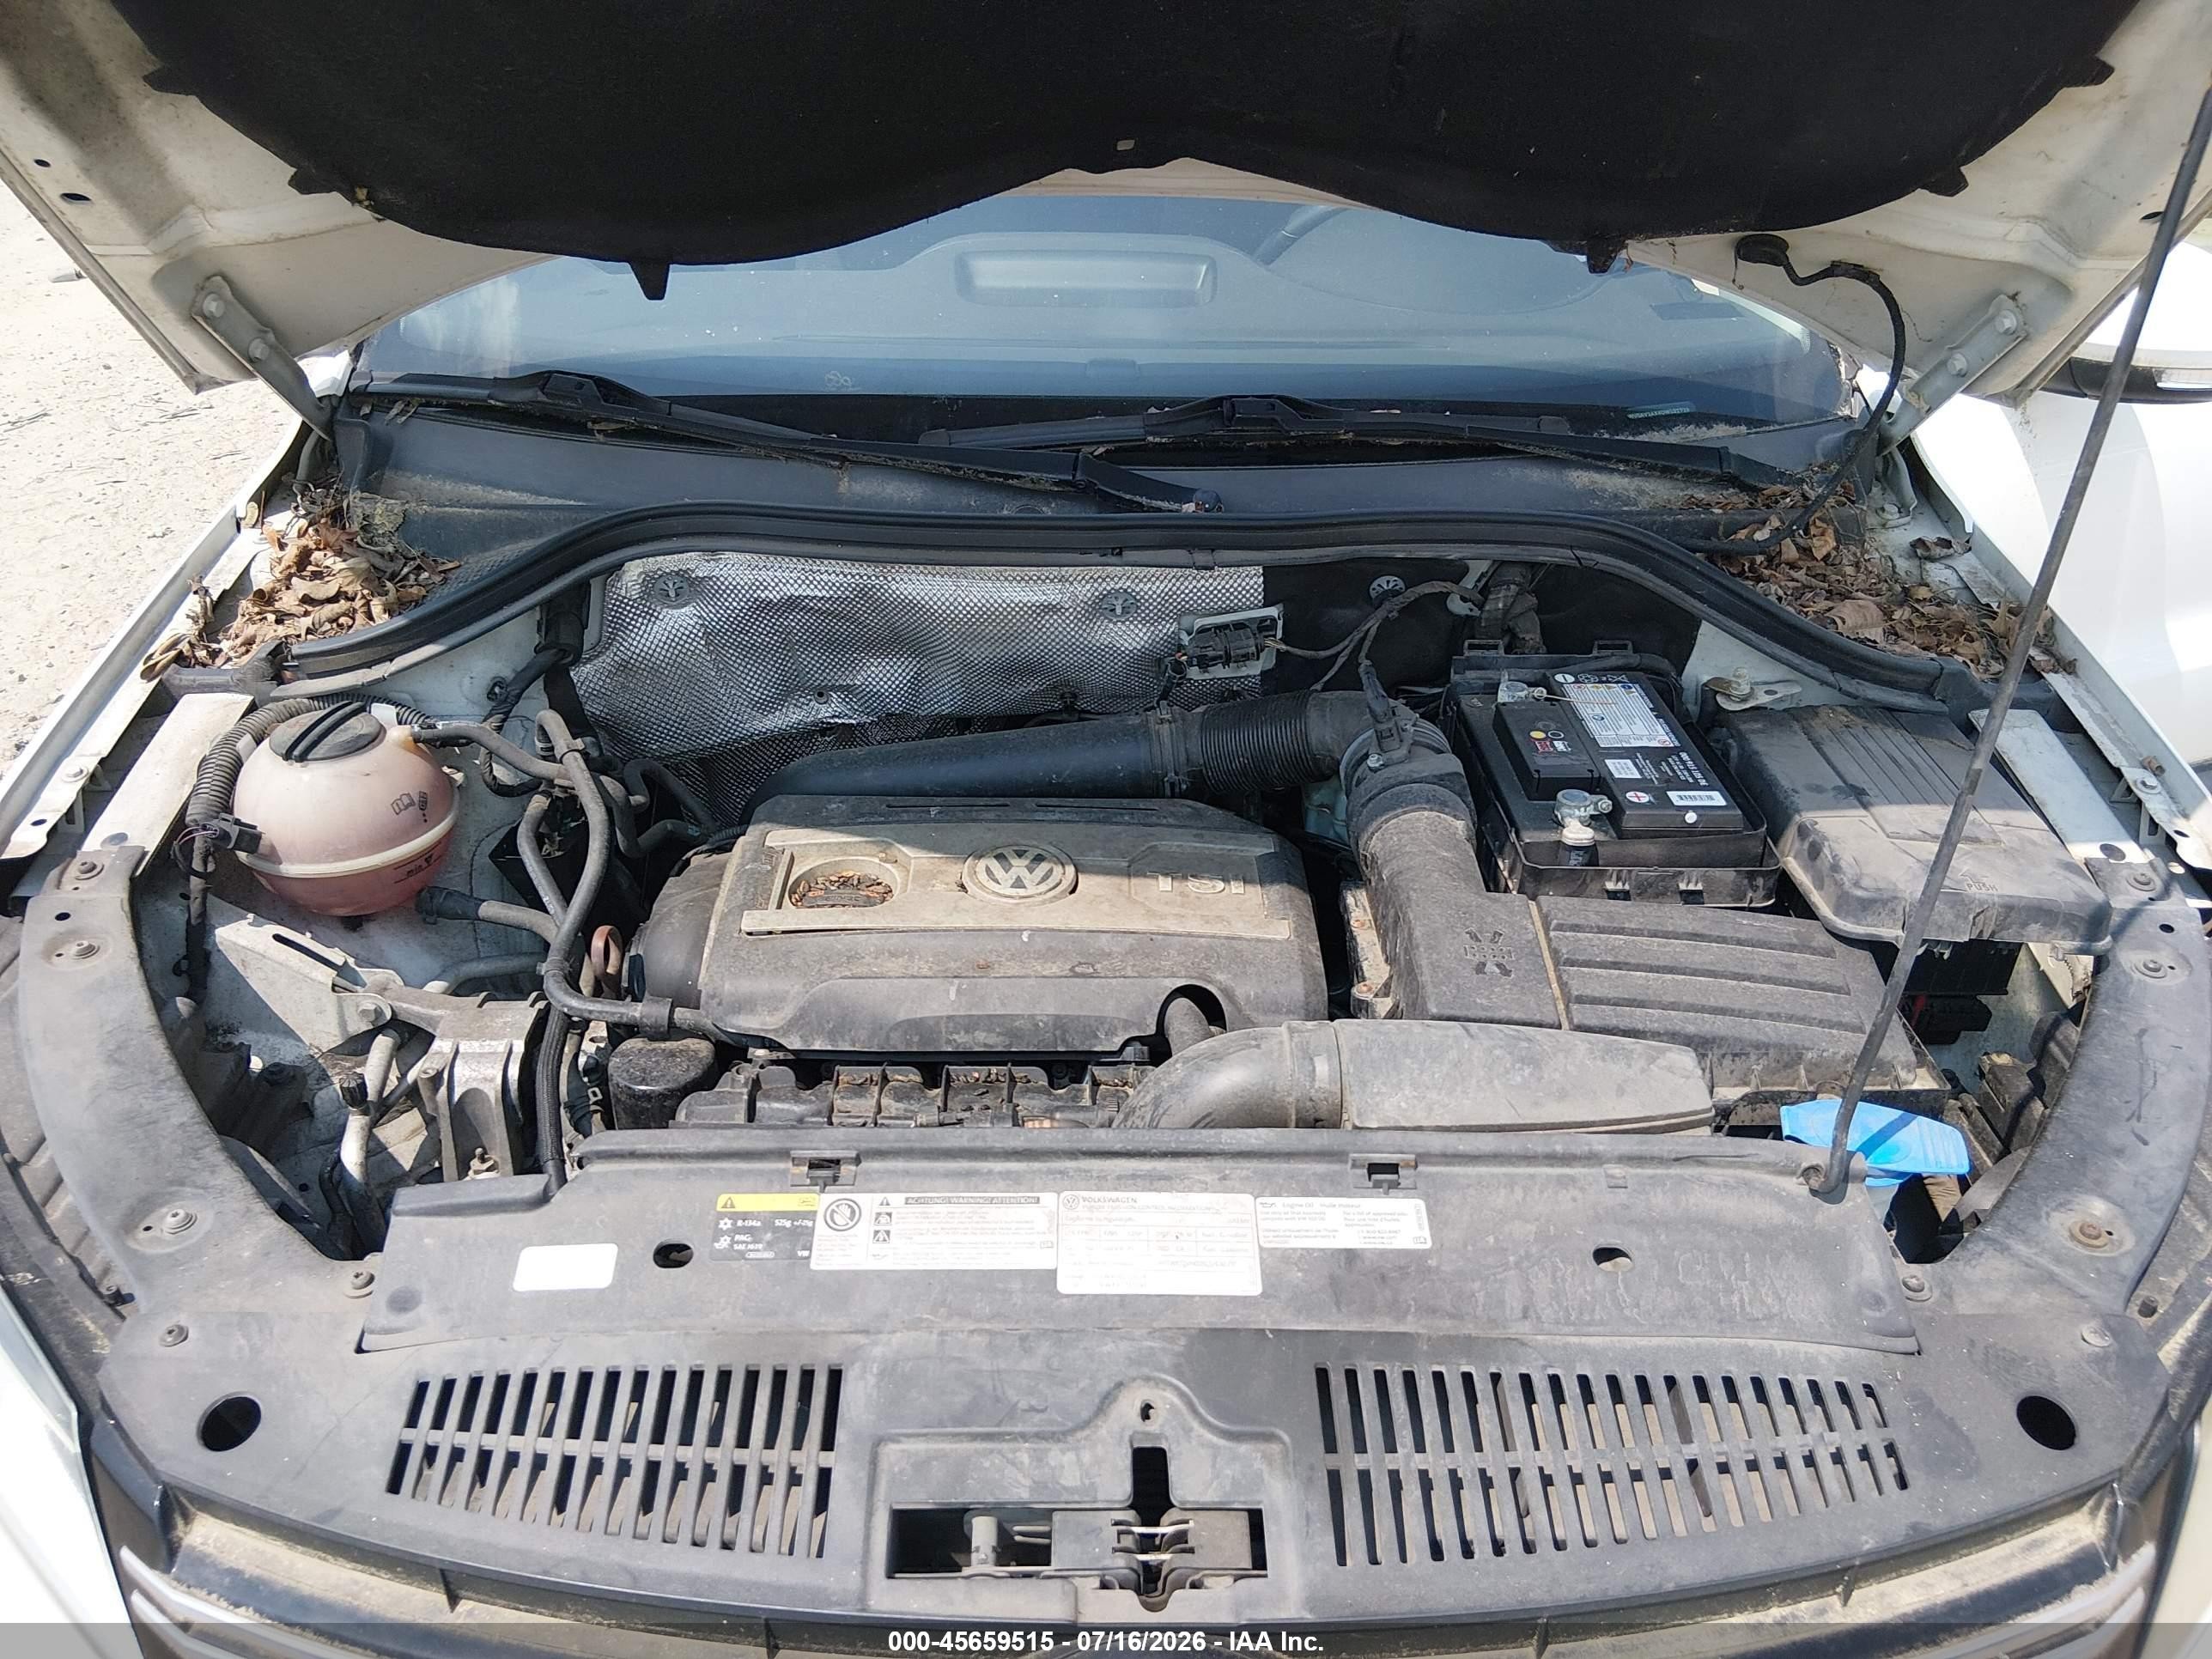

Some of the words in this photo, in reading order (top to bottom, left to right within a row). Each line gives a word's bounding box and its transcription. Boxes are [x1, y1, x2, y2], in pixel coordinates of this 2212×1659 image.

[1147, 871, 1245, 895] TSI
[1966, 882, 1998, 892] PUSH
[1081, 1195, 1138, 1204] VOLKSWAGEN
[775, 1218, 792, 1228] 525g
